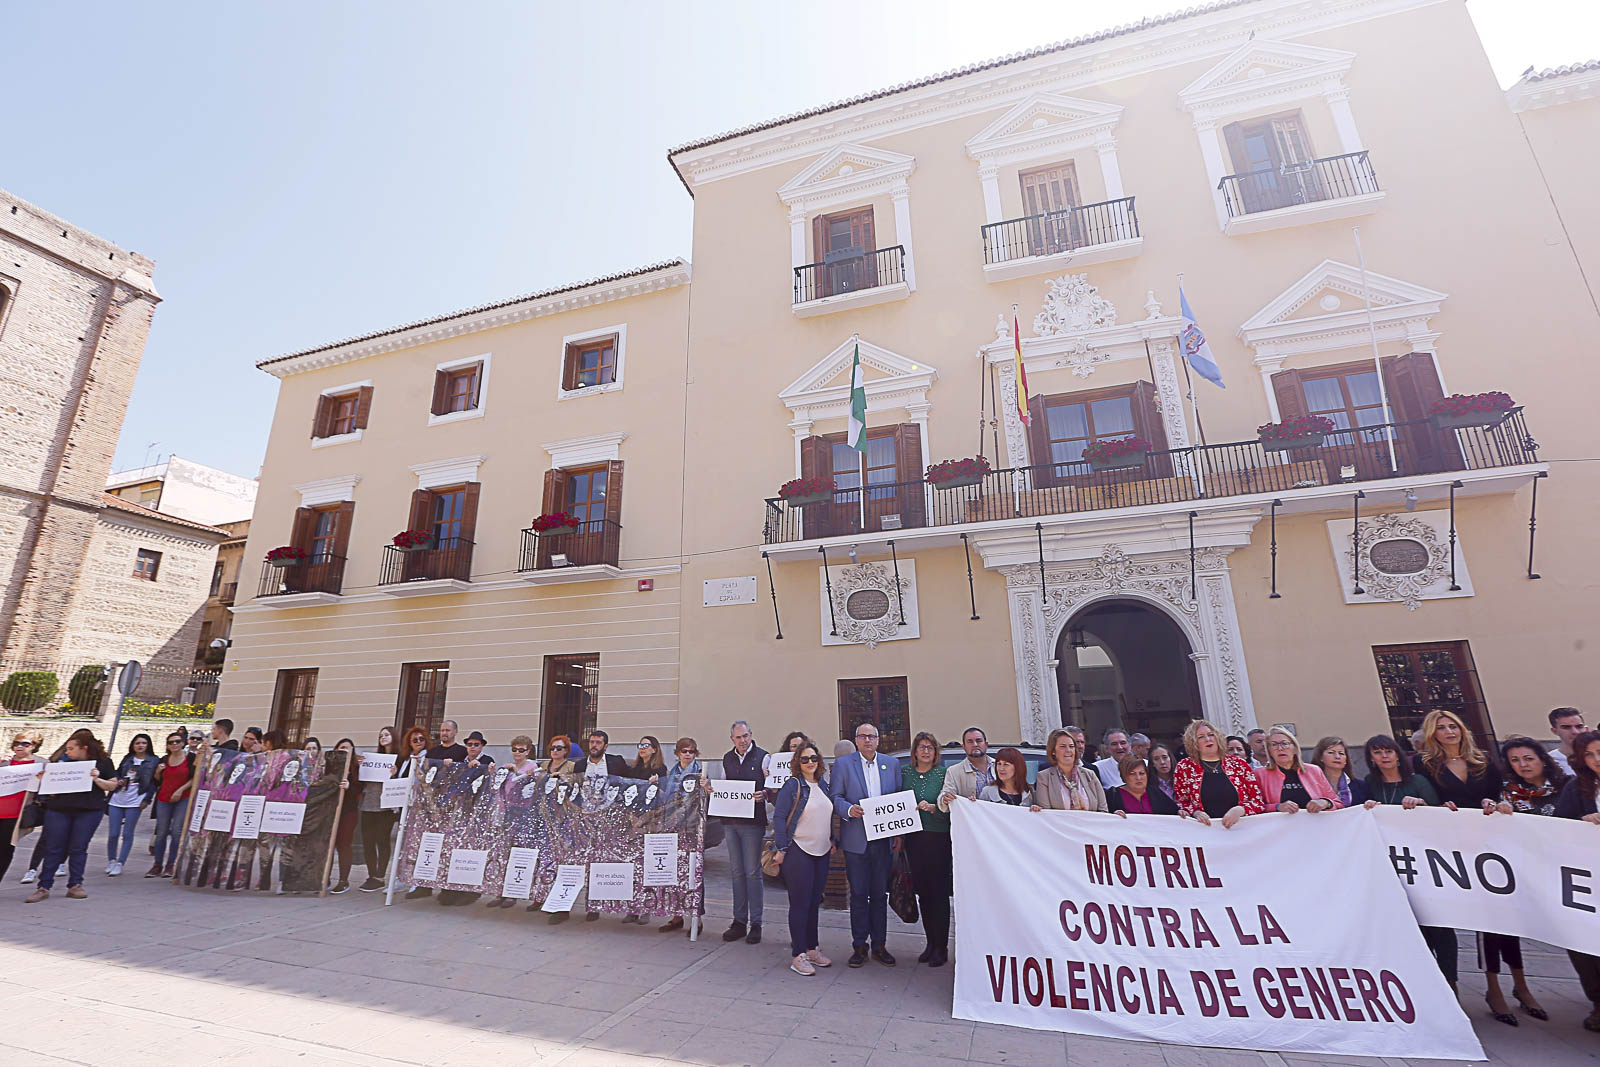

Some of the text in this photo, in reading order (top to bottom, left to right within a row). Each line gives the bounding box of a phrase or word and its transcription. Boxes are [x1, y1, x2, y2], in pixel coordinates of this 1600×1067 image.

[773, 776, 782, 784] TE
[713, 791, 753, 801] #NO ES NO
[875, 802, 906, 816] #YO SI
[873, 817, 914, 833] TE CREO
[1084, 844, 1223, 888] MOTRIL
[1389, 845, 1516, 895] #NO
[1059, 899, 1291, 949] CONTRA LA
[985, 954, 1416, 1025] VIOLENCIA DE GENERO
